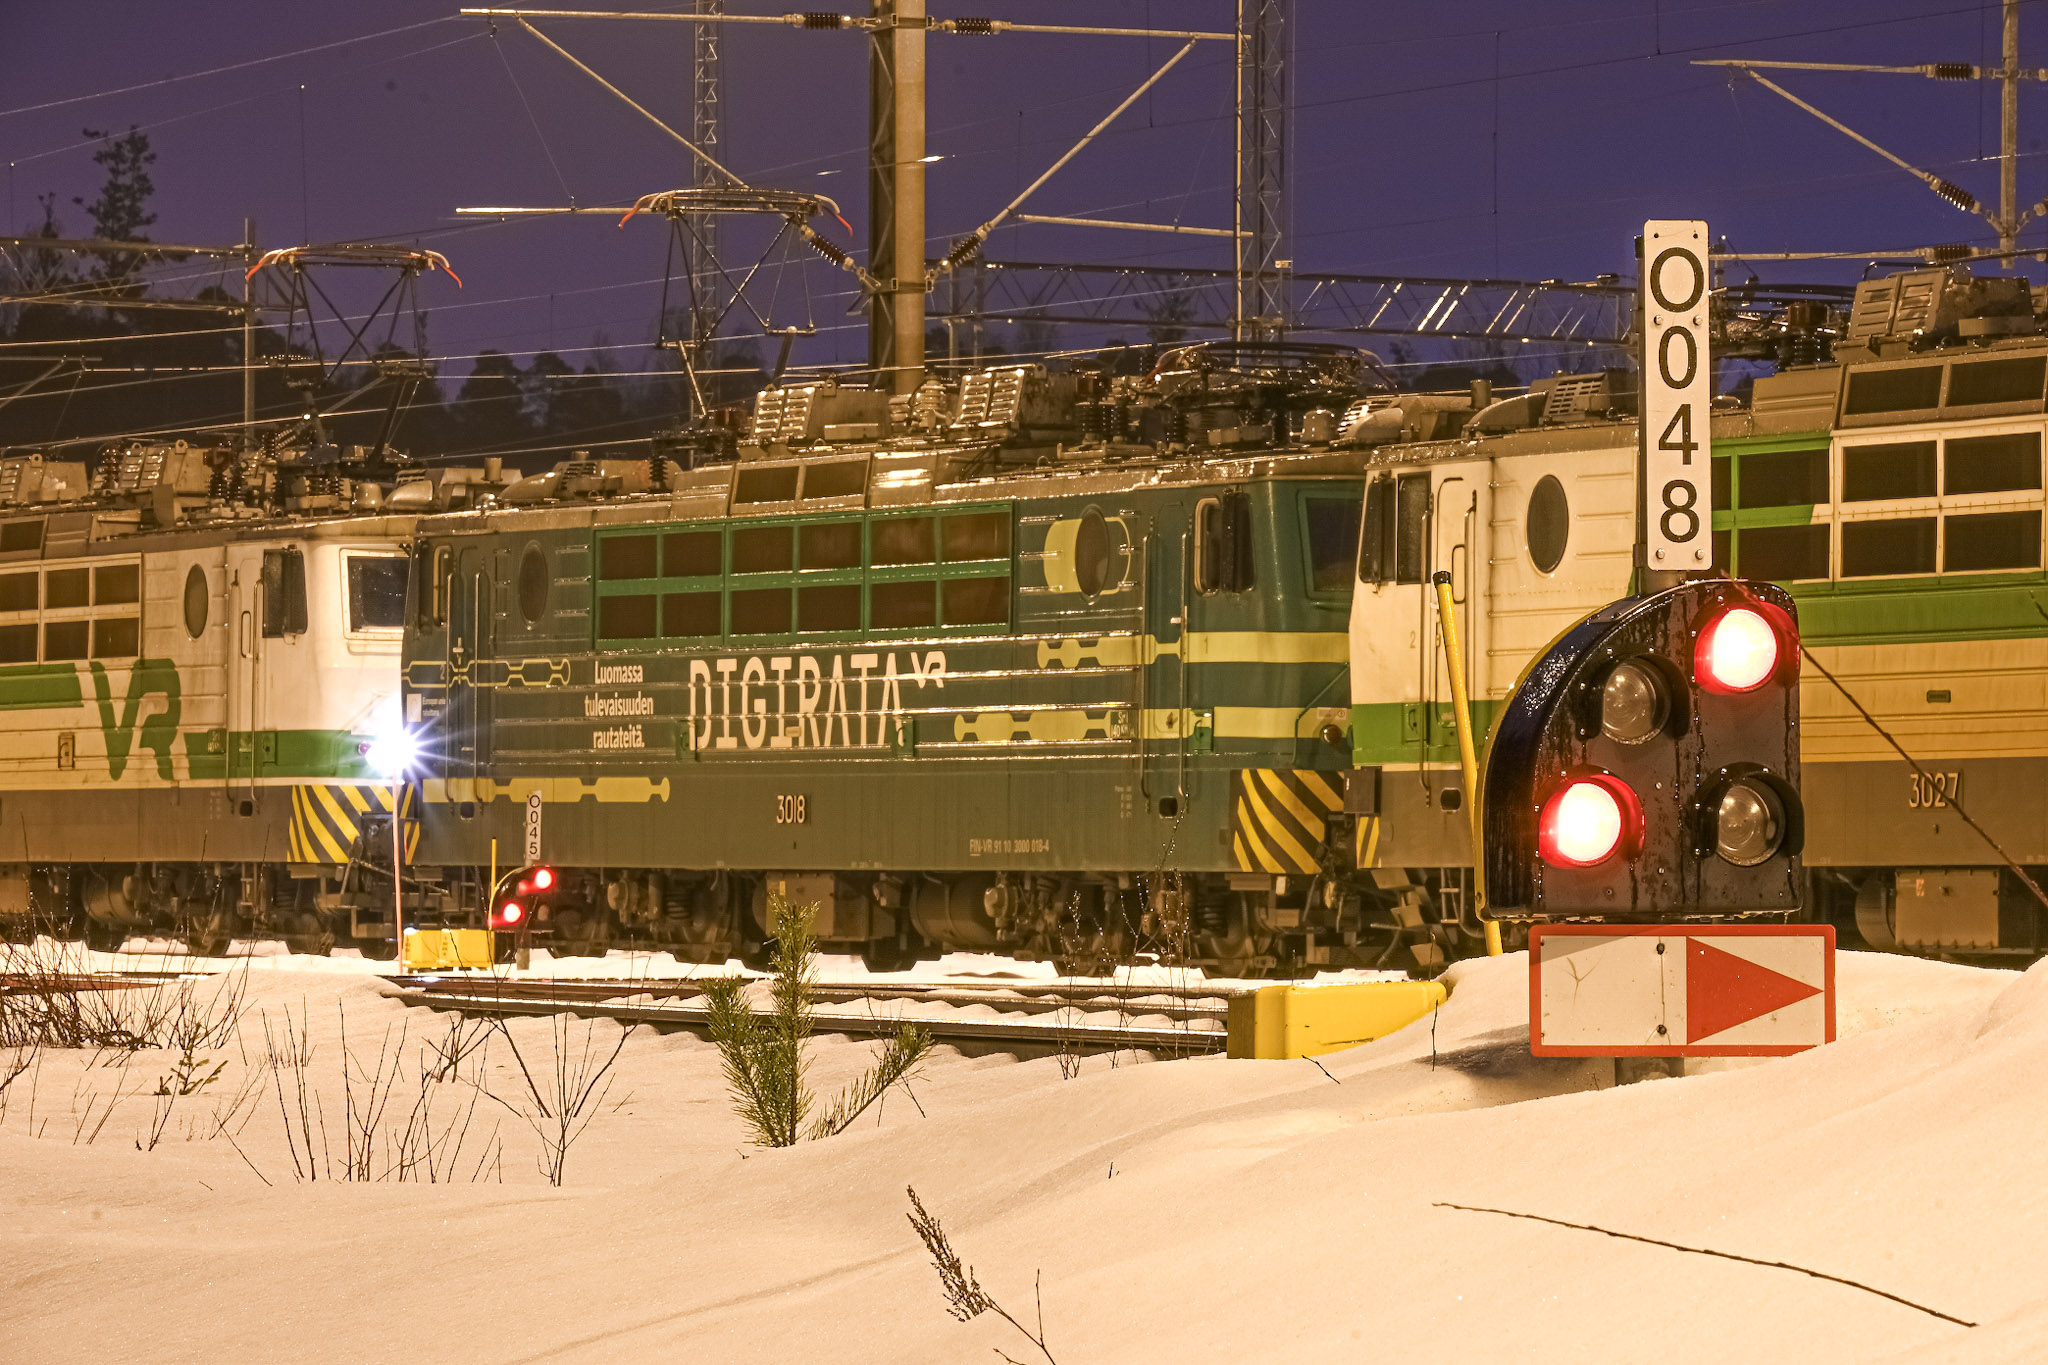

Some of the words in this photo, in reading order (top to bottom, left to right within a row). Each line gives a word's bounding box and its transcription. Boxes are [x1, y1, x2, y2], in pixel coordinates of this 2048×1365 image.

[595, 661, 643, 684] Luomassa
[584, 691, 653, 716] tulevaisuuden
[690, 653, 904, 750] DIGIRATA
[911, 651, 946, 689] VR
[90, 658, 181, 781] VR
[593, 724, 645, 748] rautateitä.
[1908, 772, 1959, 808] 3027
[776, 795, 805, 824] 3018
